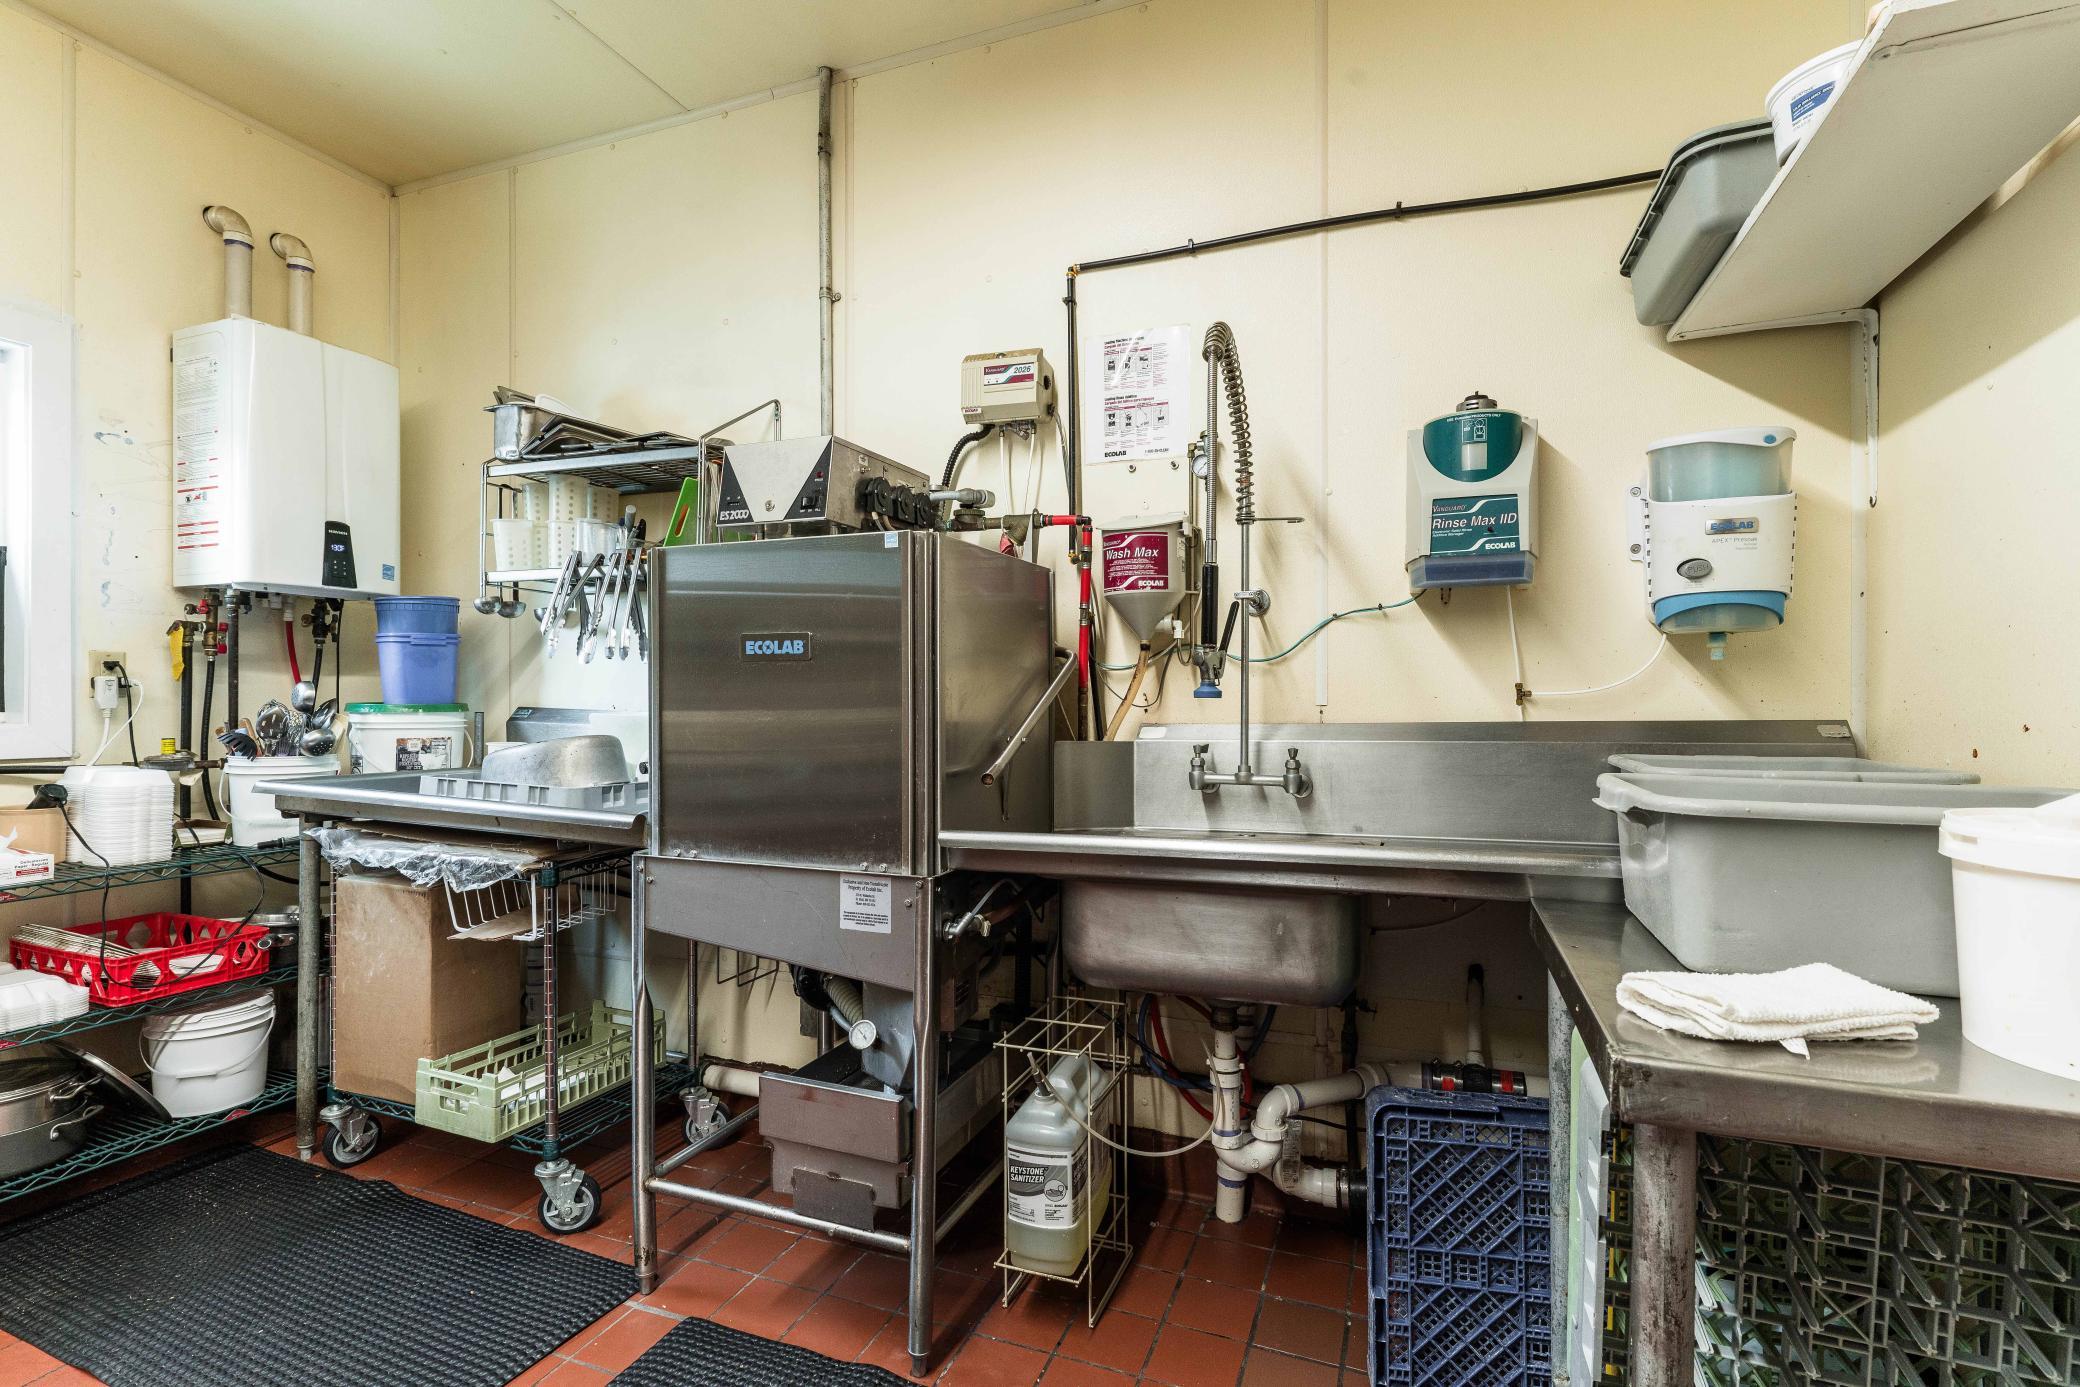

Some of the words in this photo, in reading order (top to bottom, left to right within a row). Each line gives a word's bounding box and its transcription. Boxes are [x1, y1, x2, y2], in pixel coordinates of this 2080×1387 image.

[1013, 365, 1031, 374] 2026
[1432, 517, 1467, 529] Rinse
[1470, 514, 1496, 527] Max
[1485, 541, 1516, 550] ECOLAB
[1106, 548, 1130, 560] Wash
[1134, 547, 1159, 557] Max
[1685, 563, 1709, 574] PUSH
[745, 640, 804, 655] ECOLAB
[1010, 1166, 1044, 1175] KEYSTONE
[1010, 1173, 1045, 1183] SANITIZER
